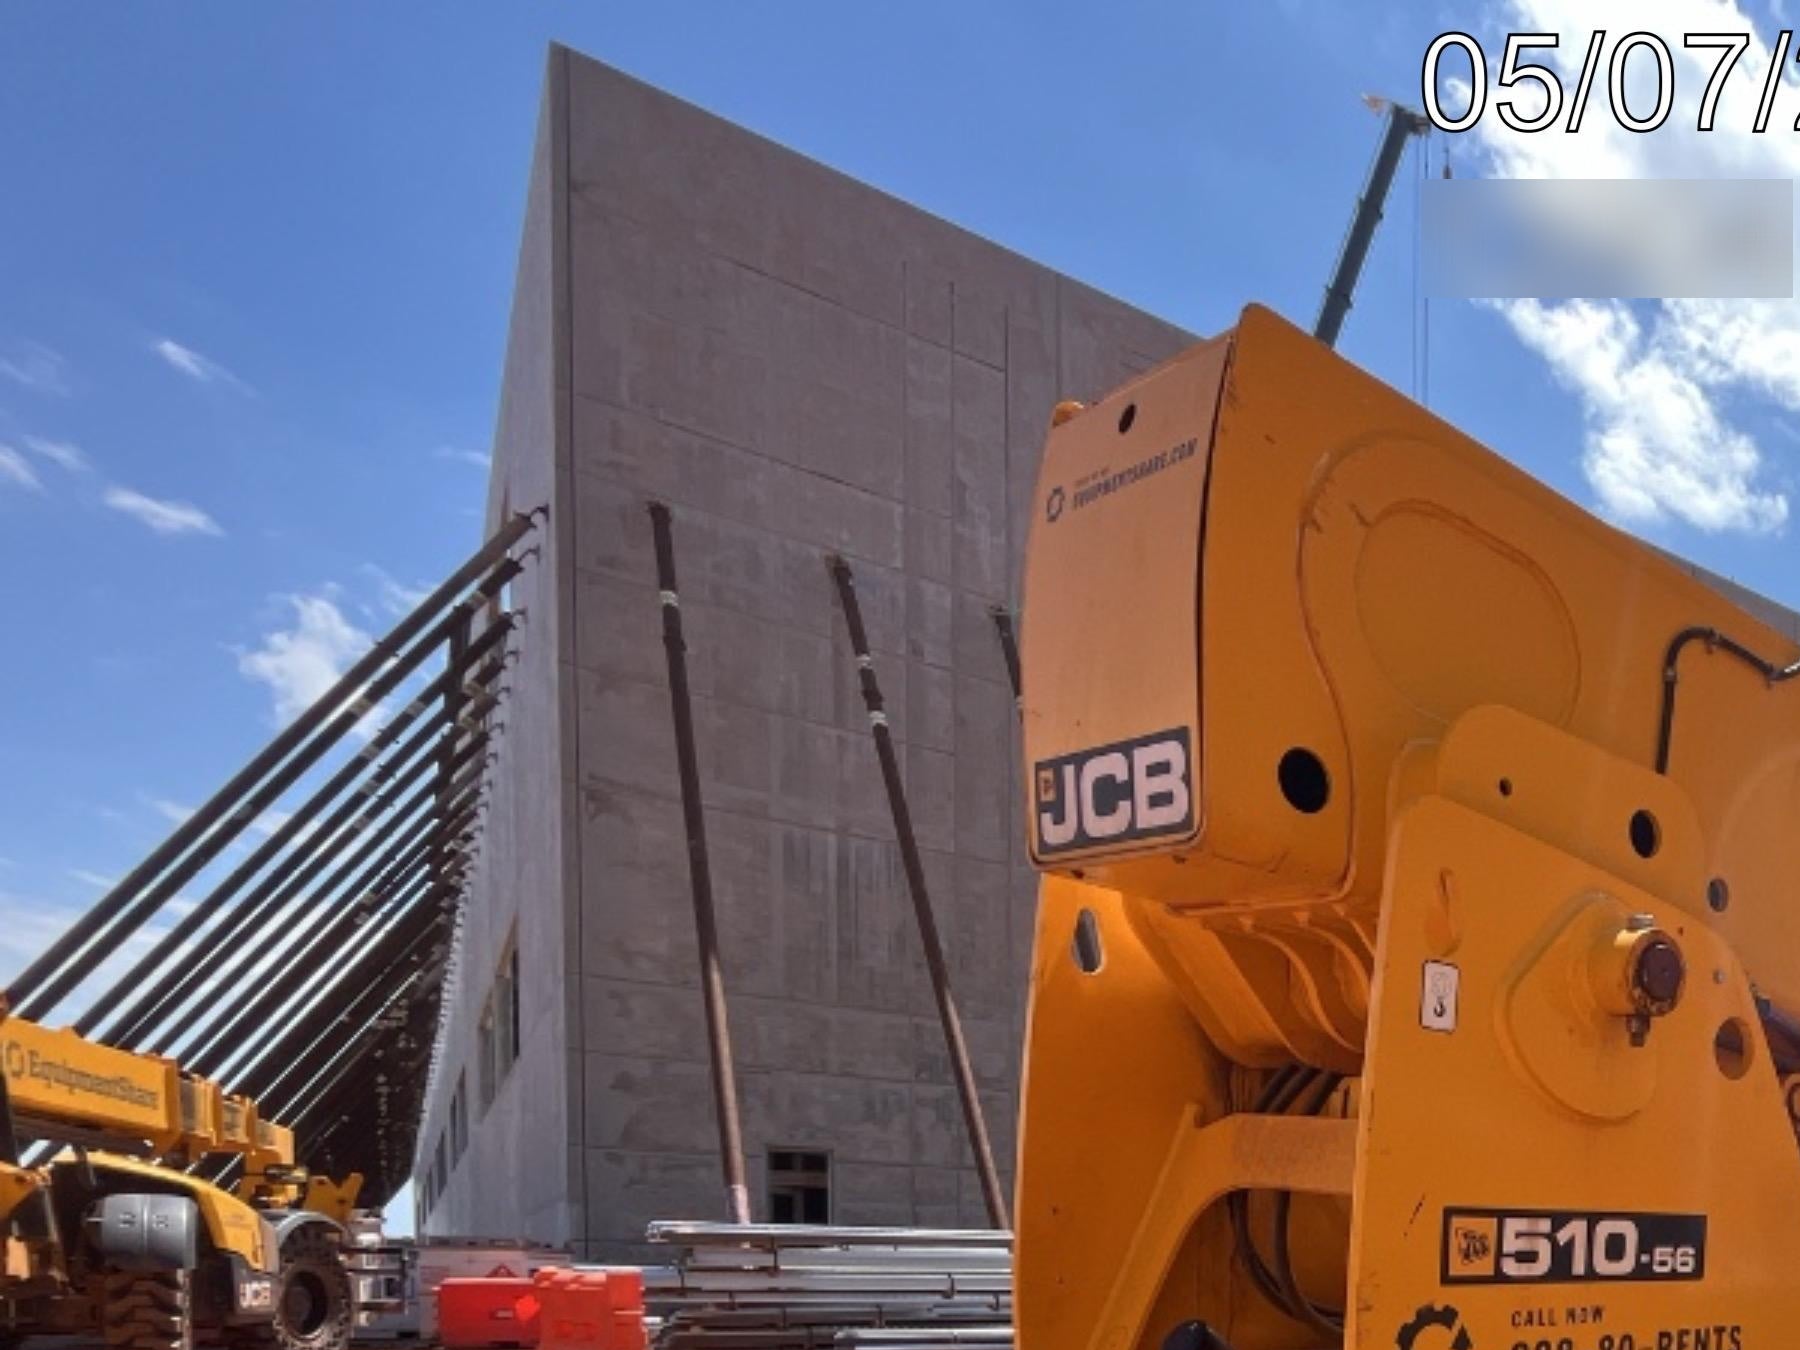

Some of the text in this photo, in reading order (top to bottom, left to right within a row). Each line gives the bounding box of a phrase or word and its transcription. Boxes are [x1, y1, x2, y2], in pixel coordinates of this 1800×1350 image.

[1040, 740, 1190, 847] JCB
[1500, 1216, 1696, 1277] 510-56
[1510, 1305, 1606, 1329] CALL NOW
